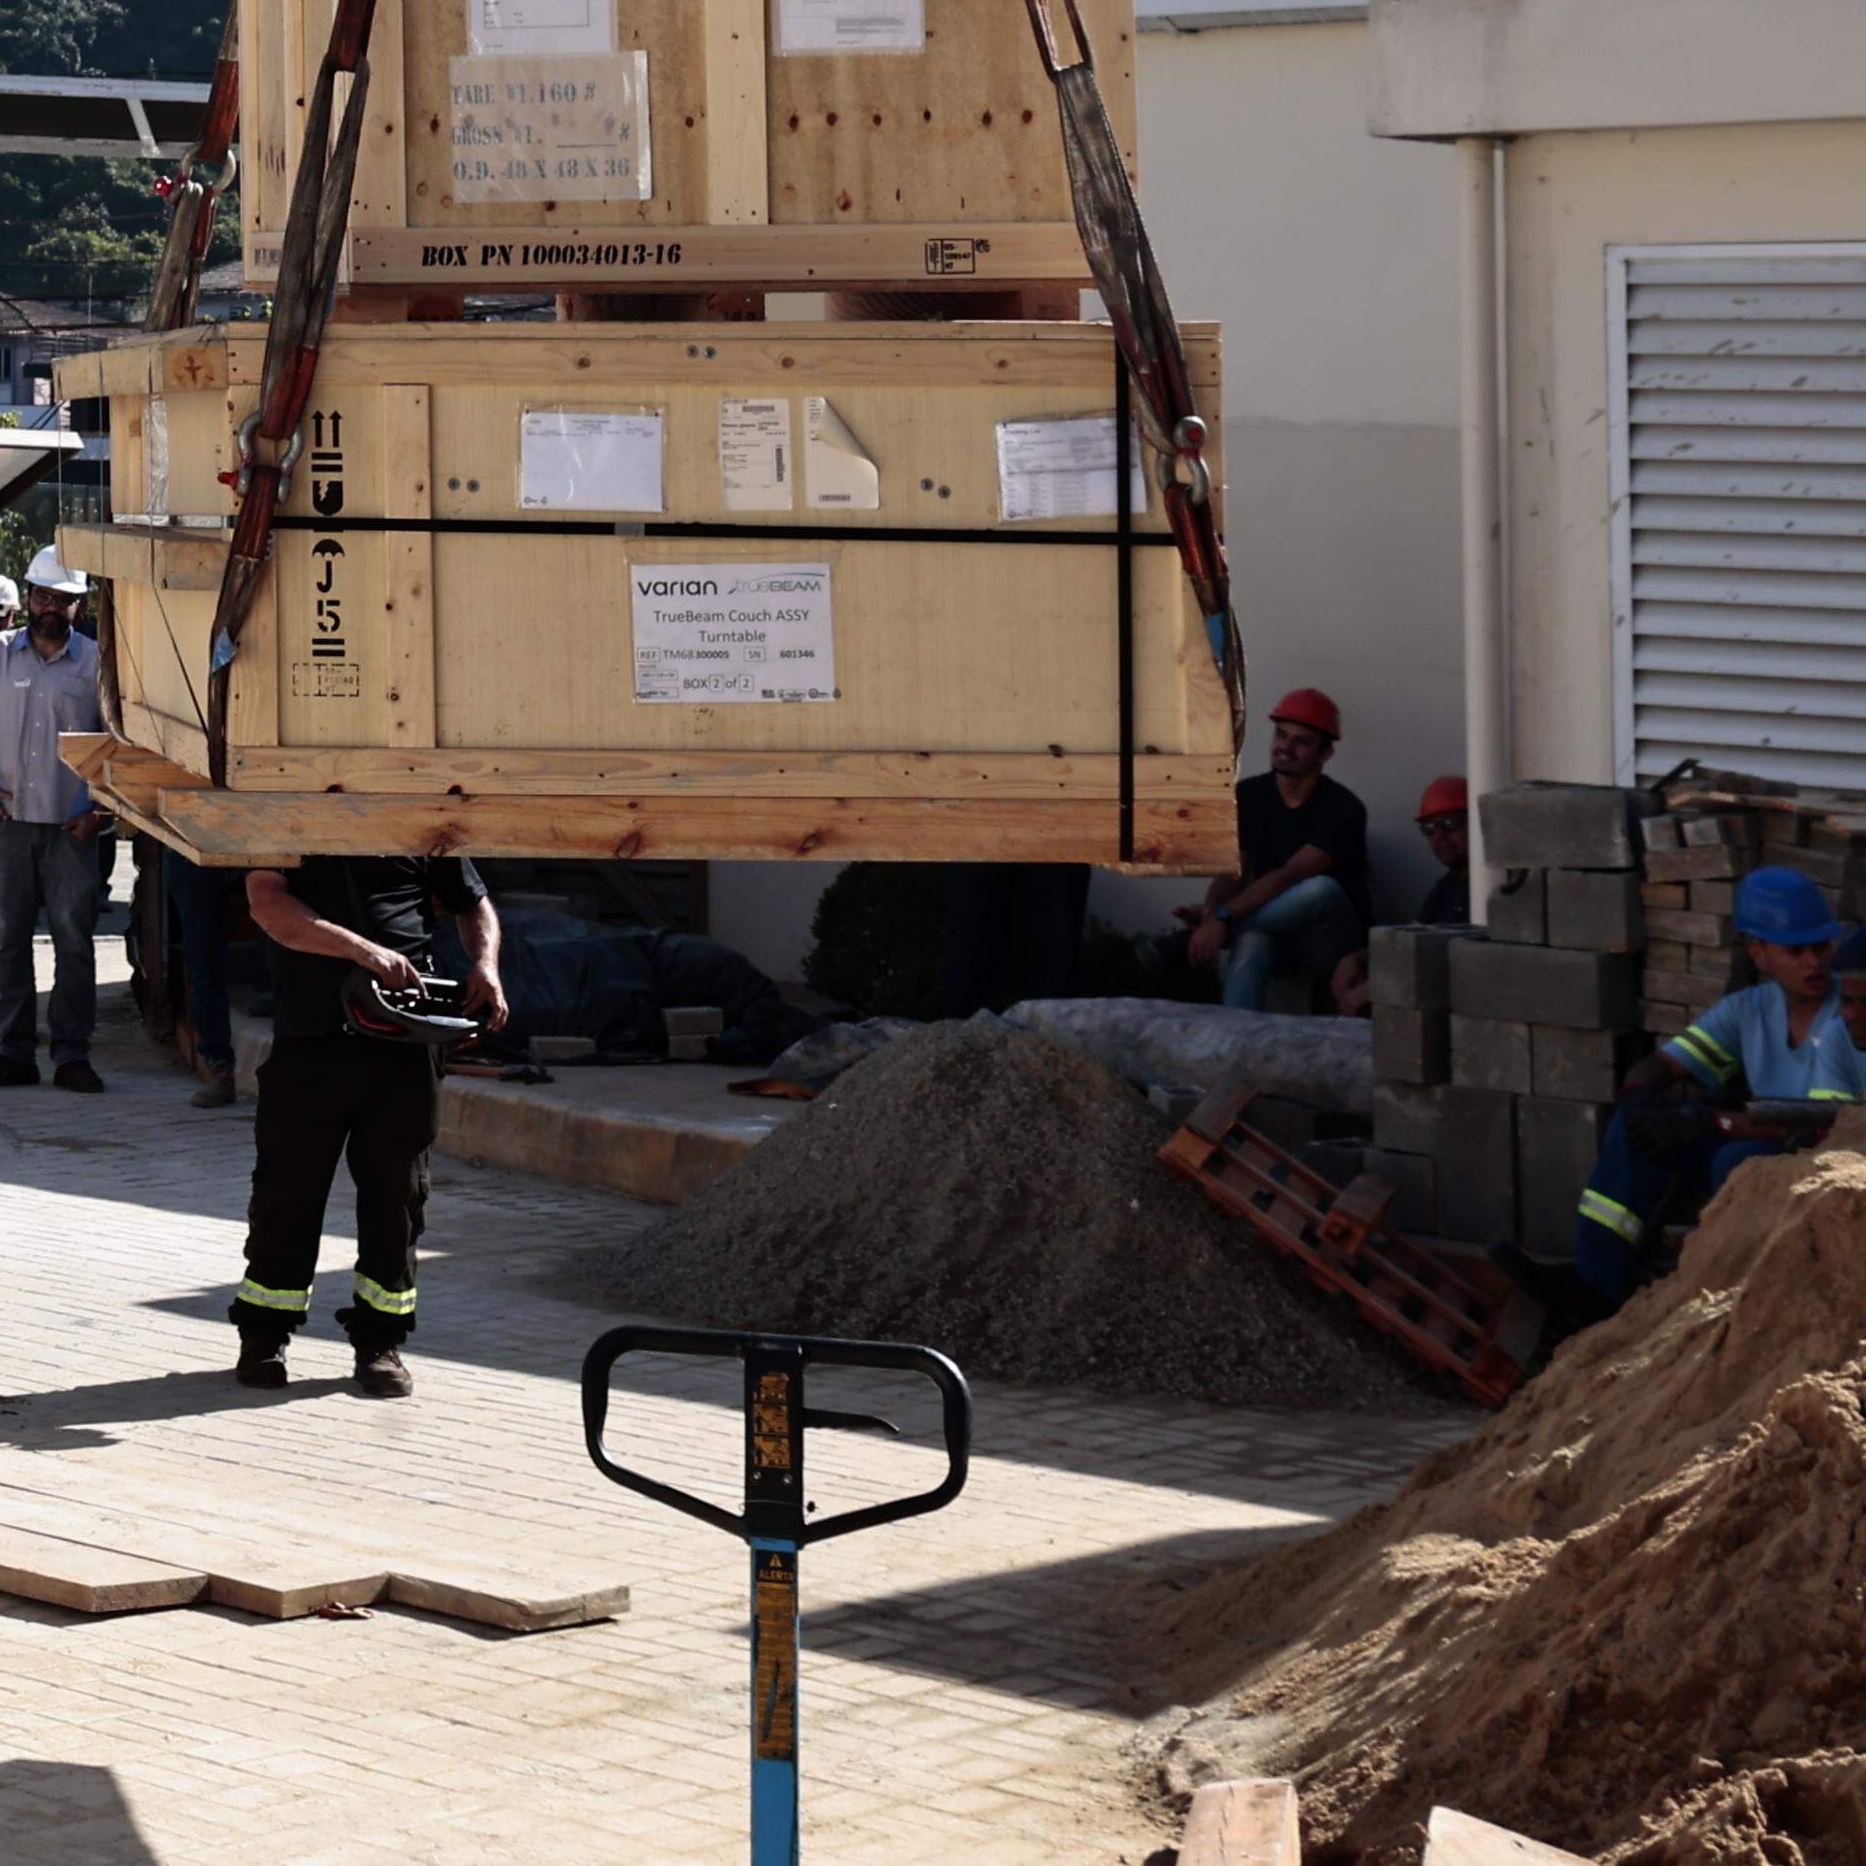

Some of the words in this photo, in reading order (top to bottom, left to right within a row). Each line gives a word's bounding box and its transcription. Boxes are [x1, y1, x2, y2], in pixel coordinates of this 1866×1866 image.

[604, 158, 630, 177] 36
[421, 245, 469, 267] BOX
[480, 245, 513, 266] PN
[520, 243, 682, 266] 100034013-16
[637, 580, 718, 597] varian
[653, 609, 725, 623] TrueBeam
[728, 609, 772, 622] Couch
[775, 608, 810, 621] ASSY
[698, 630, 766, 643] Turntable
[683, 679, 708, 690] BOX
[725, 678, 737, 689] of
